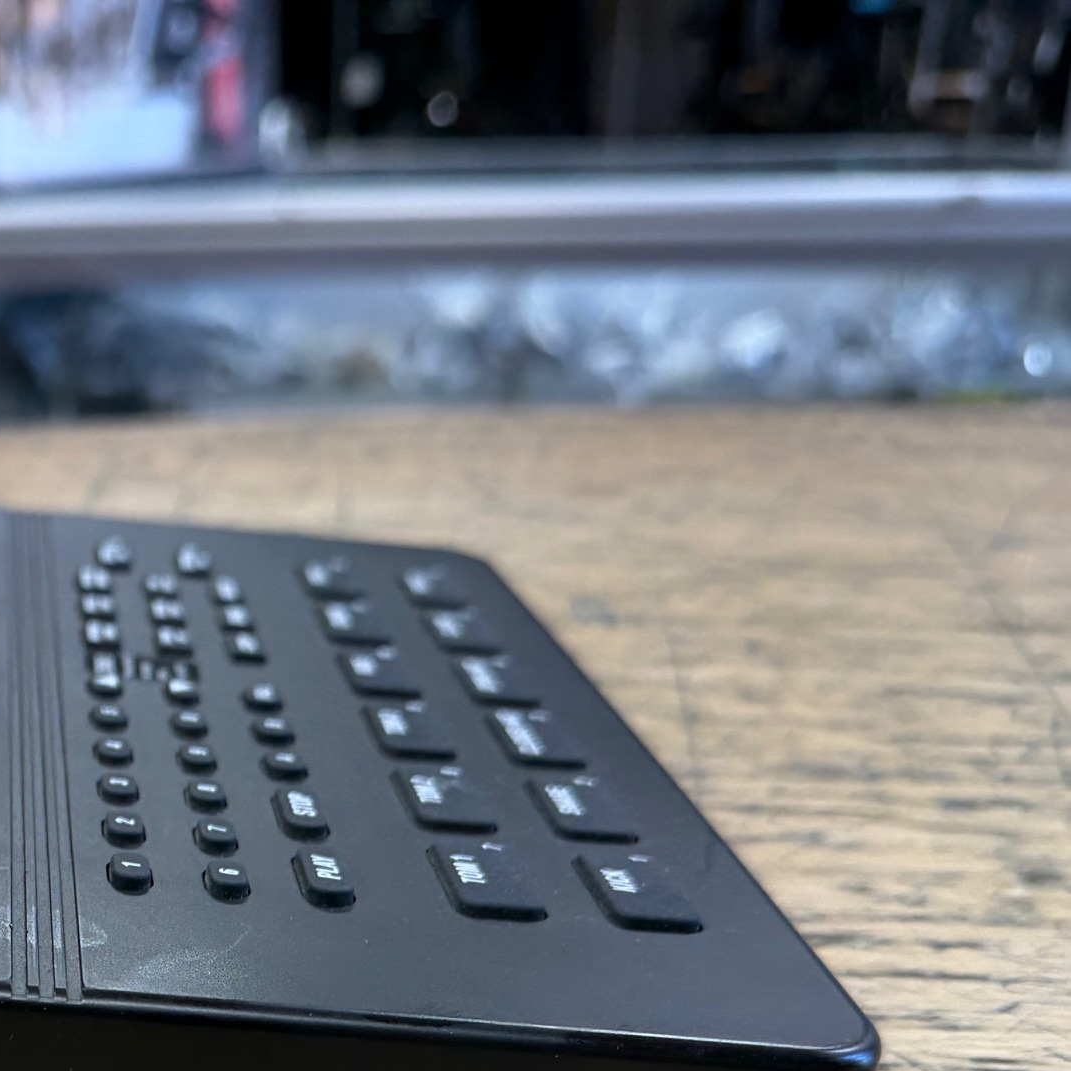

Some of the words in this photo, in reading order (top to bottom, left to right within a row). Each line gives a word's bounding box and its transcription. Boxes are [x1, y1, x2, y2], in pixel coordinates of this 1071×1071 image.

[287, 790, 317, 818] STOP
[114, 815, 136, 827] 2
[206, 823, 228, 833] 7
[120, 860, 142, 868] 1
[218, 867, 241, 877] 6
[310, 854, 342, 881] PLAY
[453, 862, 489, 884] TOM
[599, 867, 640, 894] KICK
